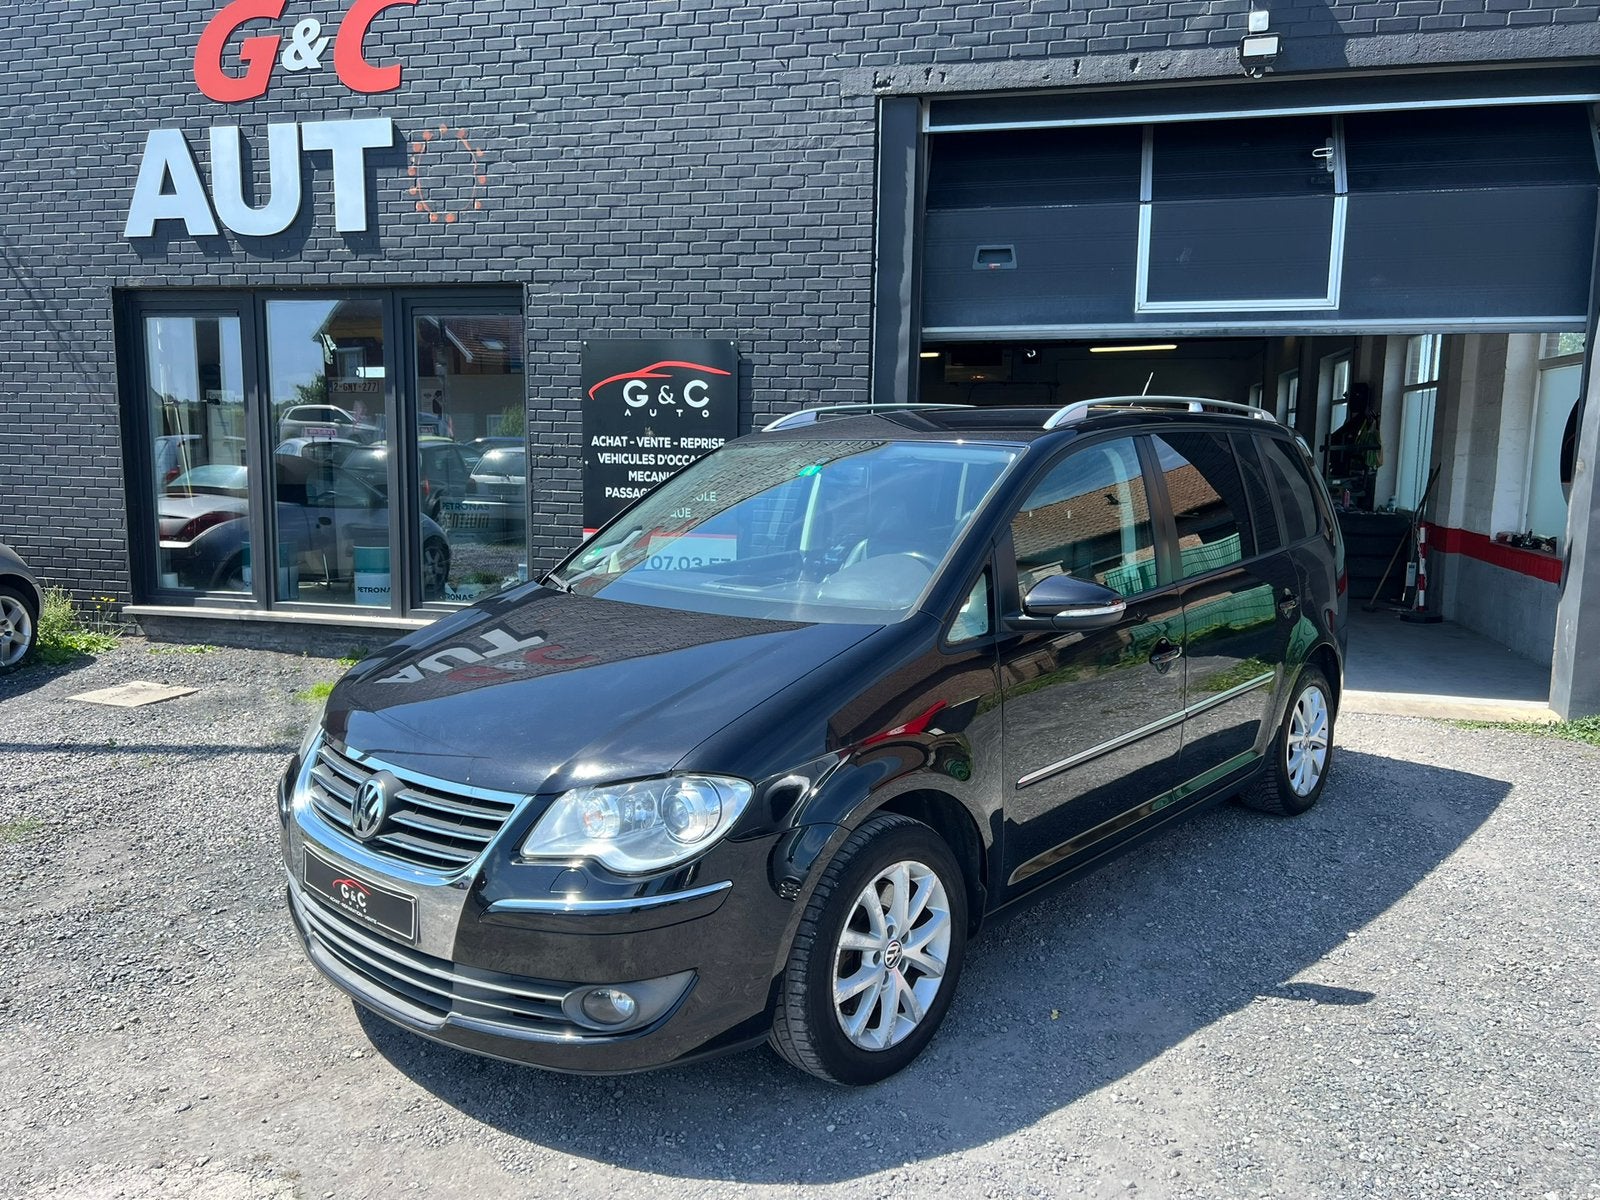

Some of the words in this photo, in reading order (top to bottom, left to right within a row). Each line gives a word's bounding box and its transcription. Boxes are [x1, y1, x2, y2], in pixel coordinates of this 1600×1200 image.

[624, 409, 710, 417] AUTO
[591, 436, 627, 447] ACHAT
[636, 437, 671, 448] VENTE
[680, 437, 725, 449] REPRISE
[598, 453, 655, 465] VEHICULES
[657, 454, 702, 466] D'OCCA
[628, 470, 674, 482] MECANI
[605, 487, 652, 498] PASSAG
